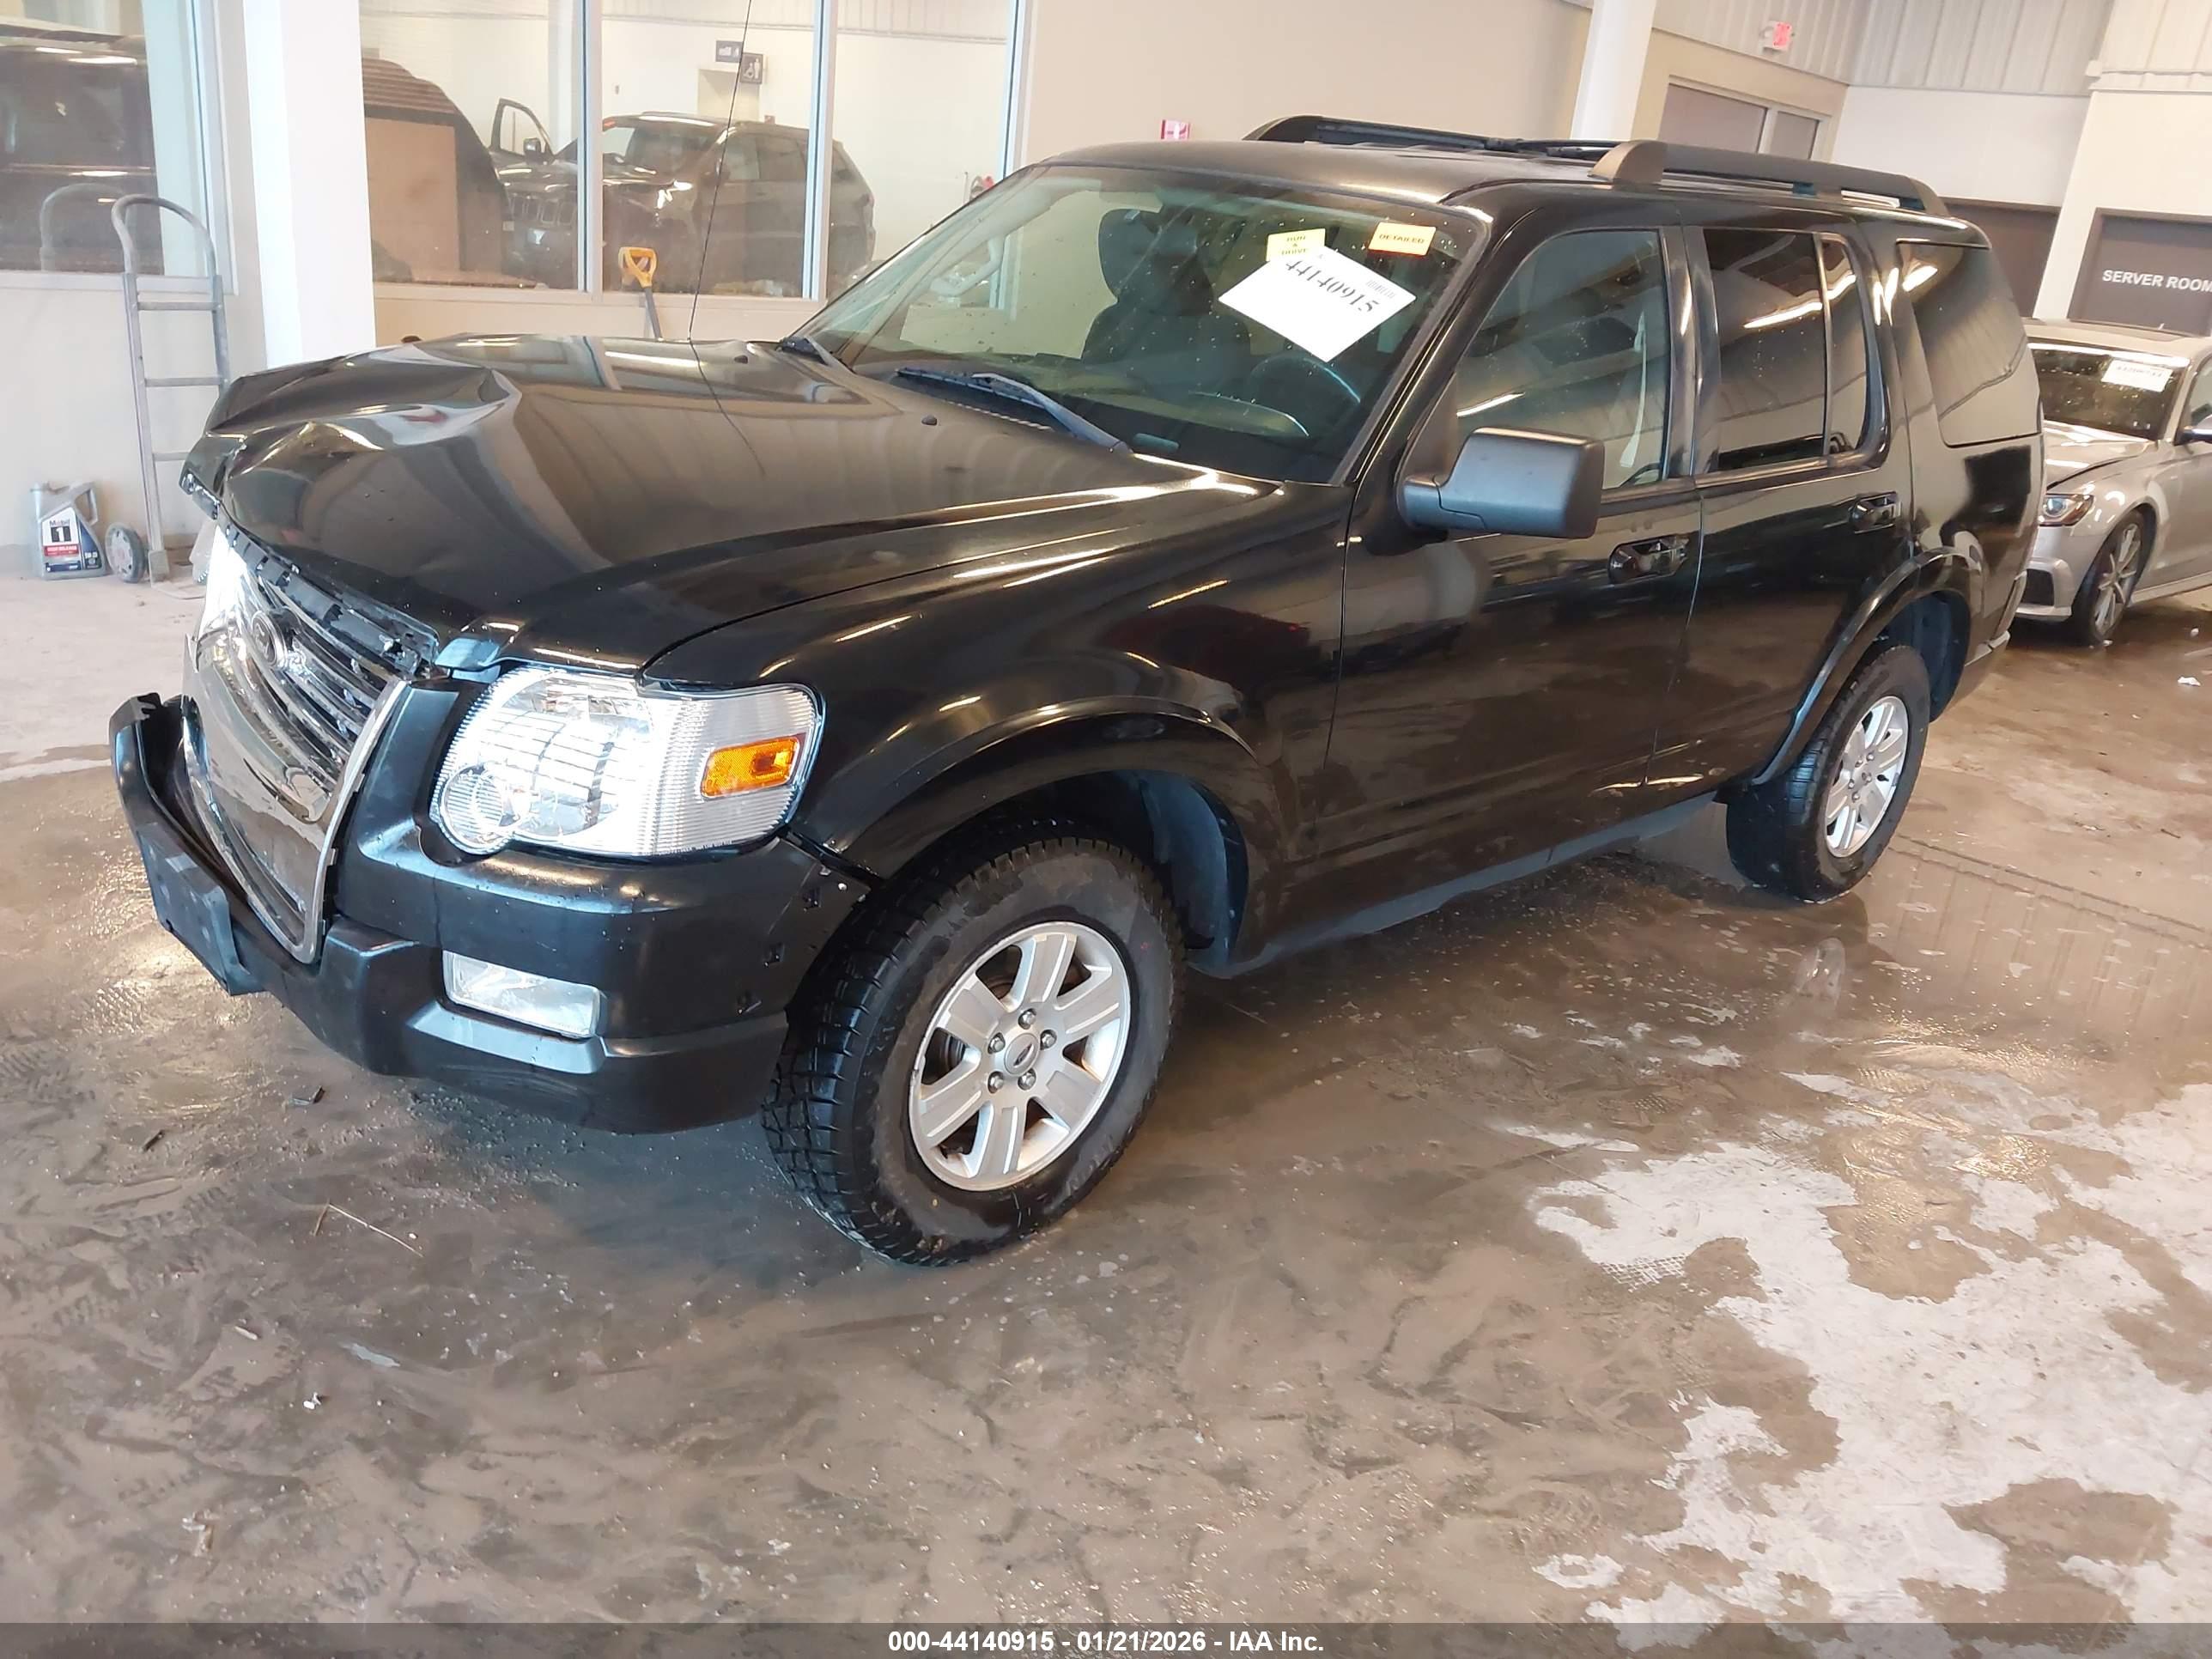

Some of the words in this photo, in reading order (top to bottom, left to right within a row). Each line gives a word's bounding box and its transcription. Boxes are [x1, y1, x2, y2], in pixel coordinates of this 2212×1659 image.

[1378, 233, 1425, 245] DETAILED
[1285, 259, 1380, 313] 44140915
[2102, 269, 2164, 288] SERVER
